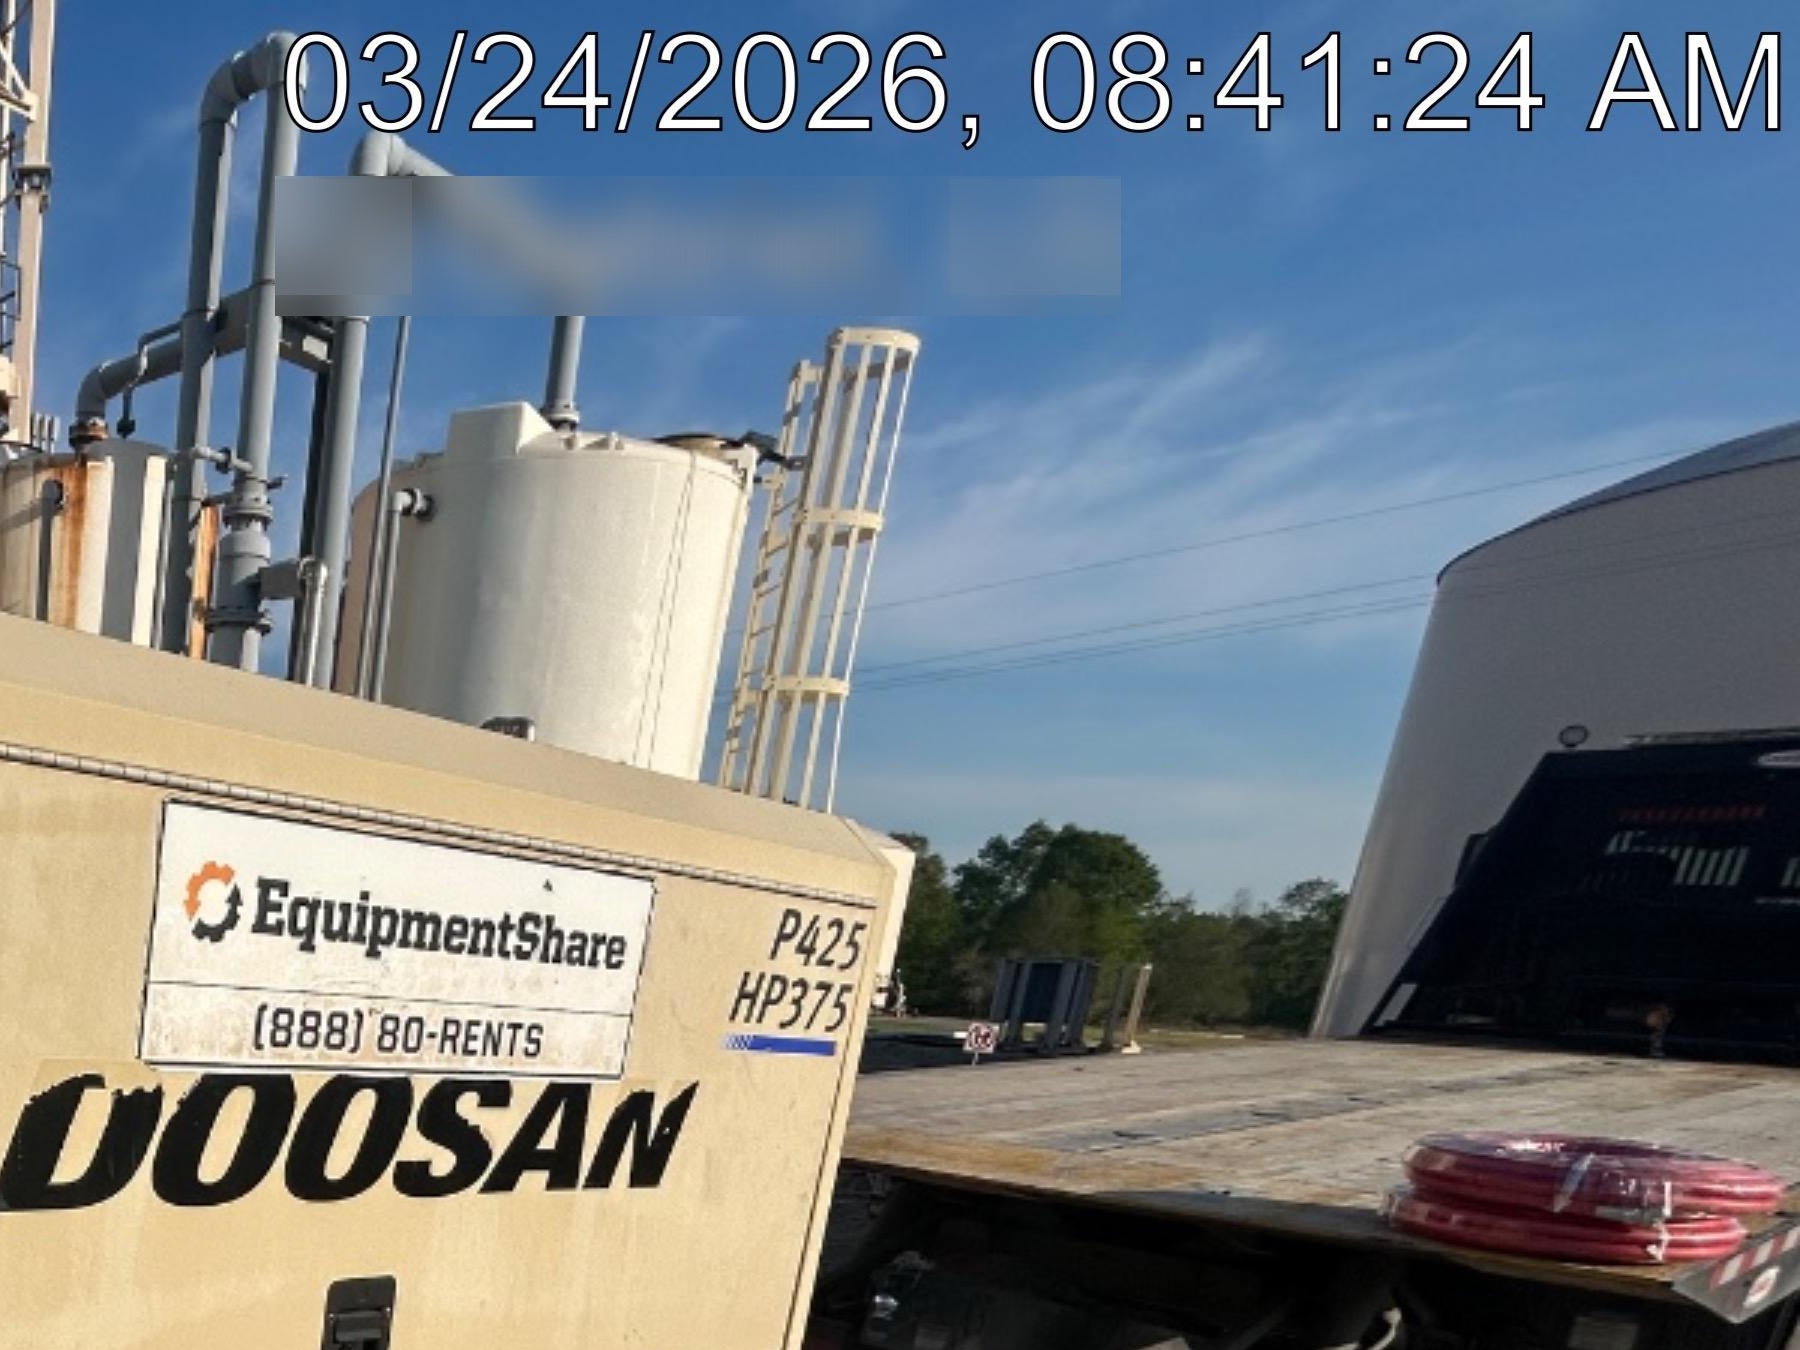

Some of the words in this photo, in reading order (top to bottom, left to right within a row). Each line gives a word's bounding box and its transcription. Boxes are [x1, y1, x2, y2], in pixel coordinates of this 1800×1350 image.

[250, 877, 627, 970] EquipmentShare
[769, 908, 868, 971] P425
[253, 1003, 364, 1055] (888)
[376, 1013, 545, 1058] 80-RENTS
[728, 971, 854, 1033] HP375
